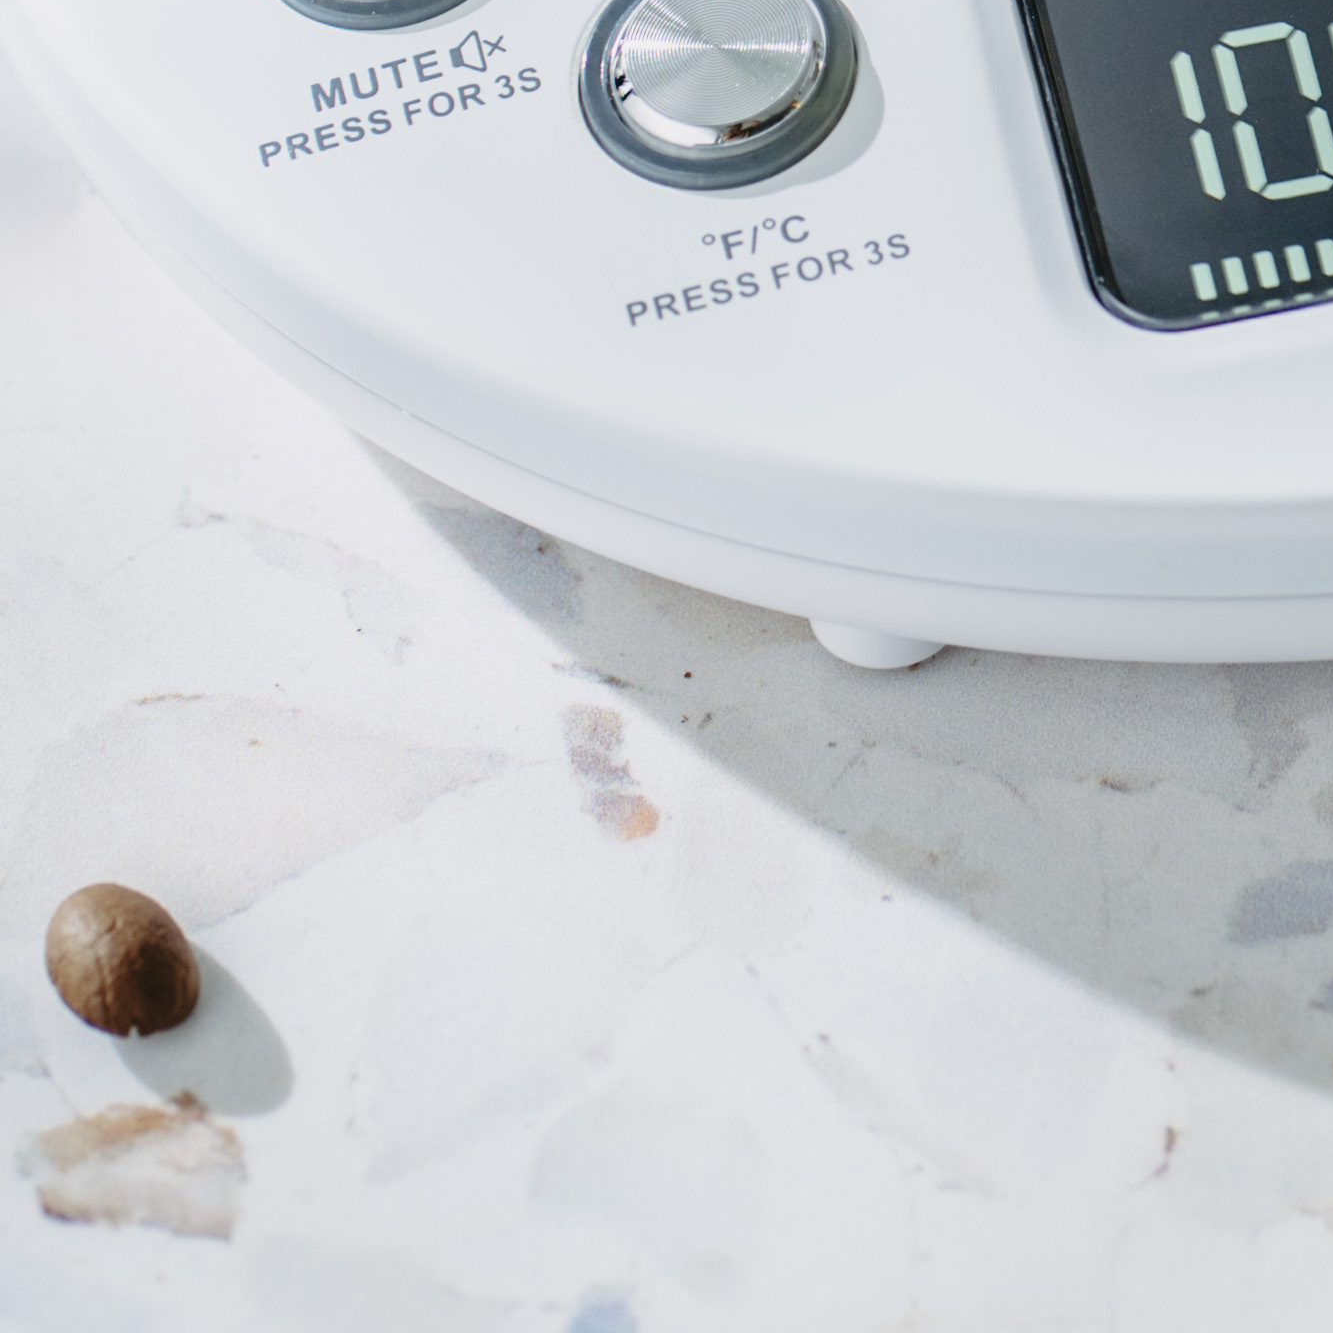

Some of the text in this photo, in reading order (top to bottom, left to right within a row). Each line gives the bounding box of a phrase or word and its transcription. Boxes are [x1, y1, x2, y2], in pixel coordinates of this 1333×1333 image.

[258, 67, 543, 168] PRESS FOR 3S
[310, 49, 444, 113] MUTE
[624, 233, 911, 327] PRESS FOR 3S
